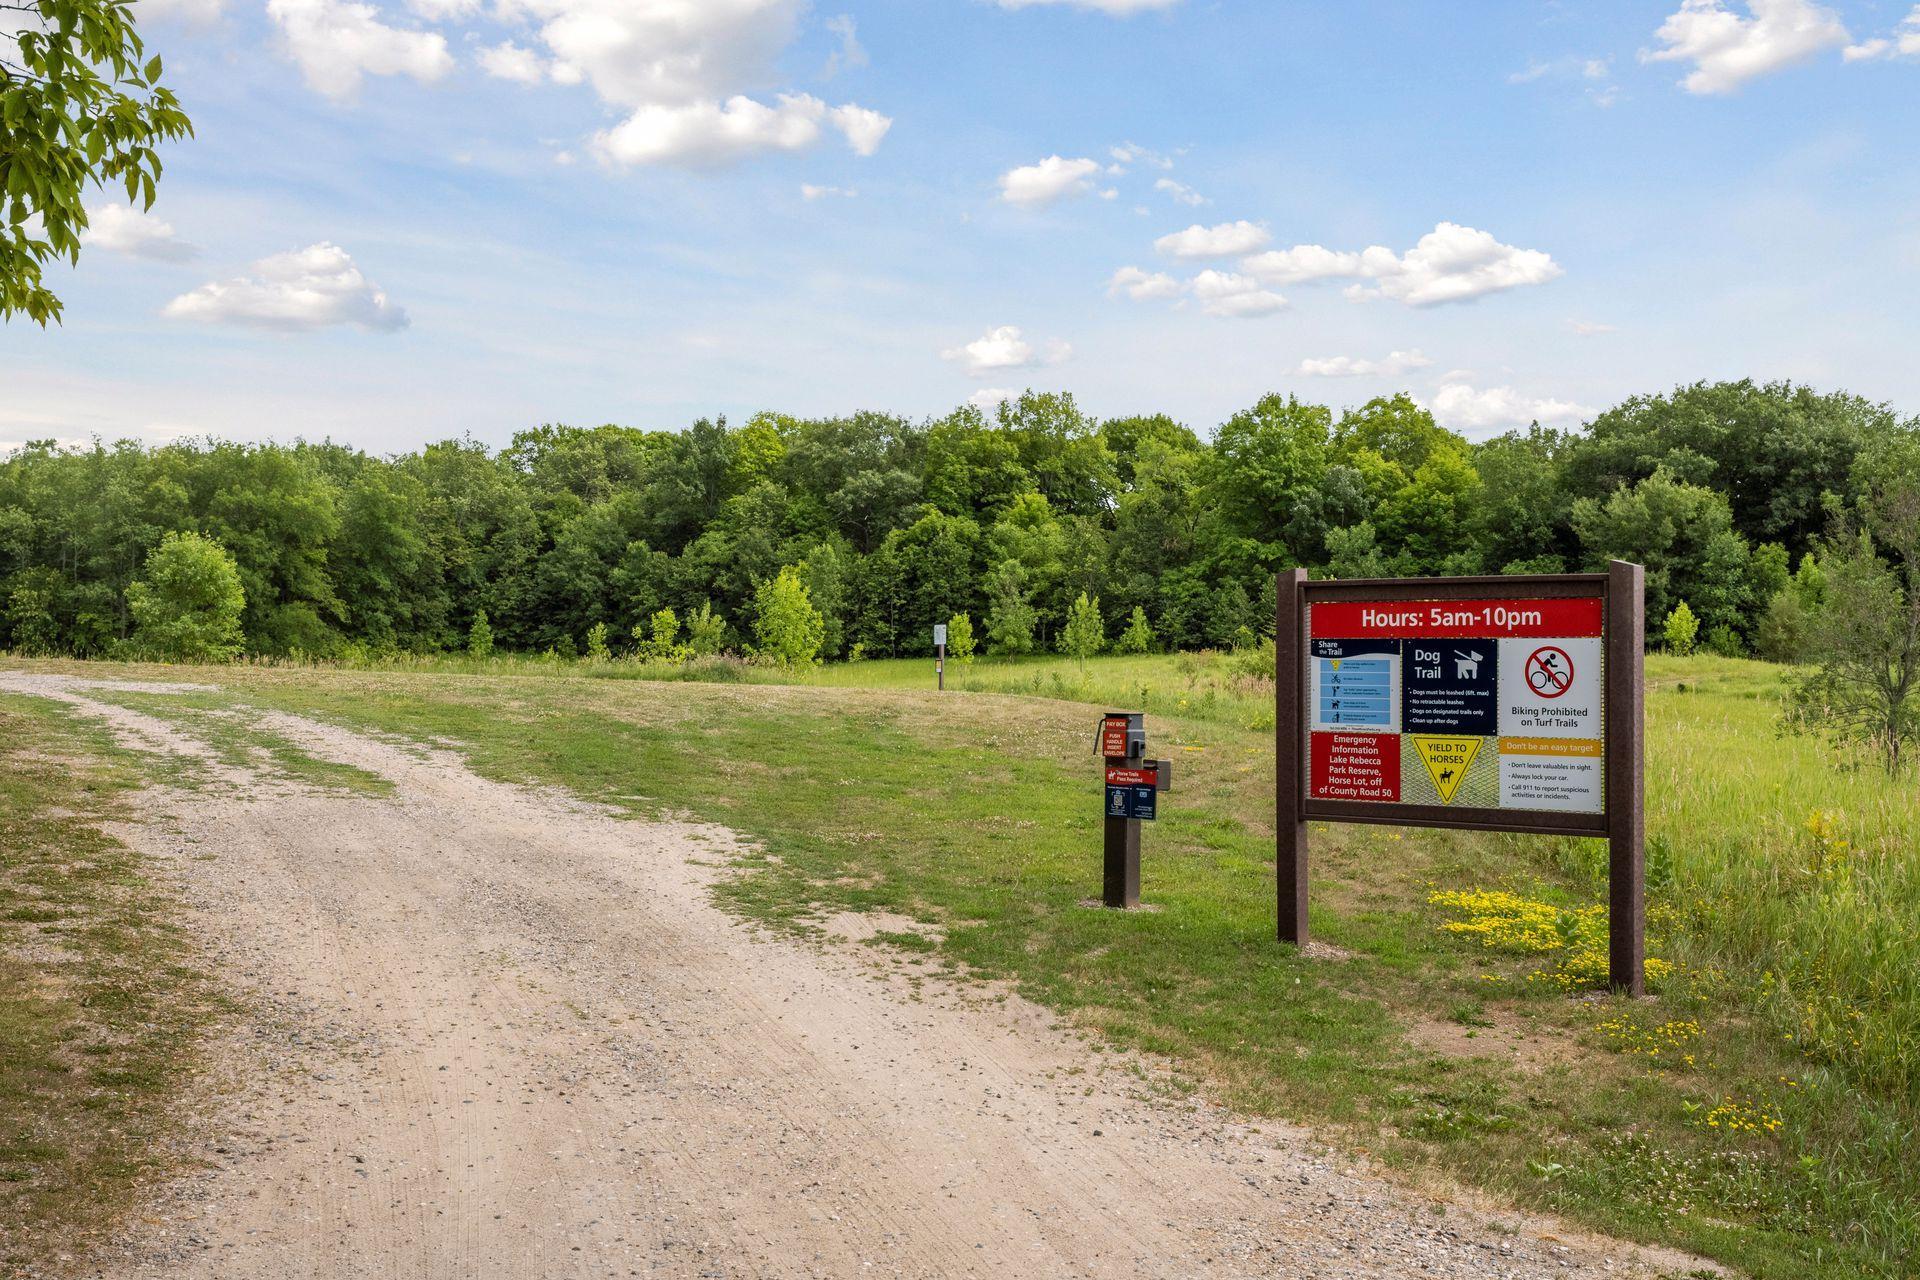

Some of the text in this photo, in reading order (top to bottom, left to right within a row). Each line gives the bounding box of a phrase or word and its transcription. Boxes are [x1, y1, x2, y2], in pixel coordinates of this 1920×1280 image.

[1362, 607, 1542, 631] Hours: 5am-10pm
[1318, 640, 1338, 648] Share
[1415, 649, 1440, 664] Dog
[1414, 666, 1441, 678] Trail
[1512, 706, 1588, 717] Biking Prohibited
[1535, 718, 1552, 726] Turf
[1555, 719, 1578, 728] Trails
[1334, 735, 1376, 746] Emergency
[1332, 745, 1378, 755] Information
[1428, 744, 1467, 752] YIELD TO
[1551, 744, 1568, 752] easy
[1570, 745, 1594, 753] target
[1330, 755, 1382, 765] Lake Rebecca
[1430, 755, 1464, 764] HORSES
[1329, 766, 1382, 776] Park Reserve,
[1329, 776, 1382, 786] Horse Lot, off
[1330, 787, 1358, 797] County
[1360, 788, 1380, 796] Road
